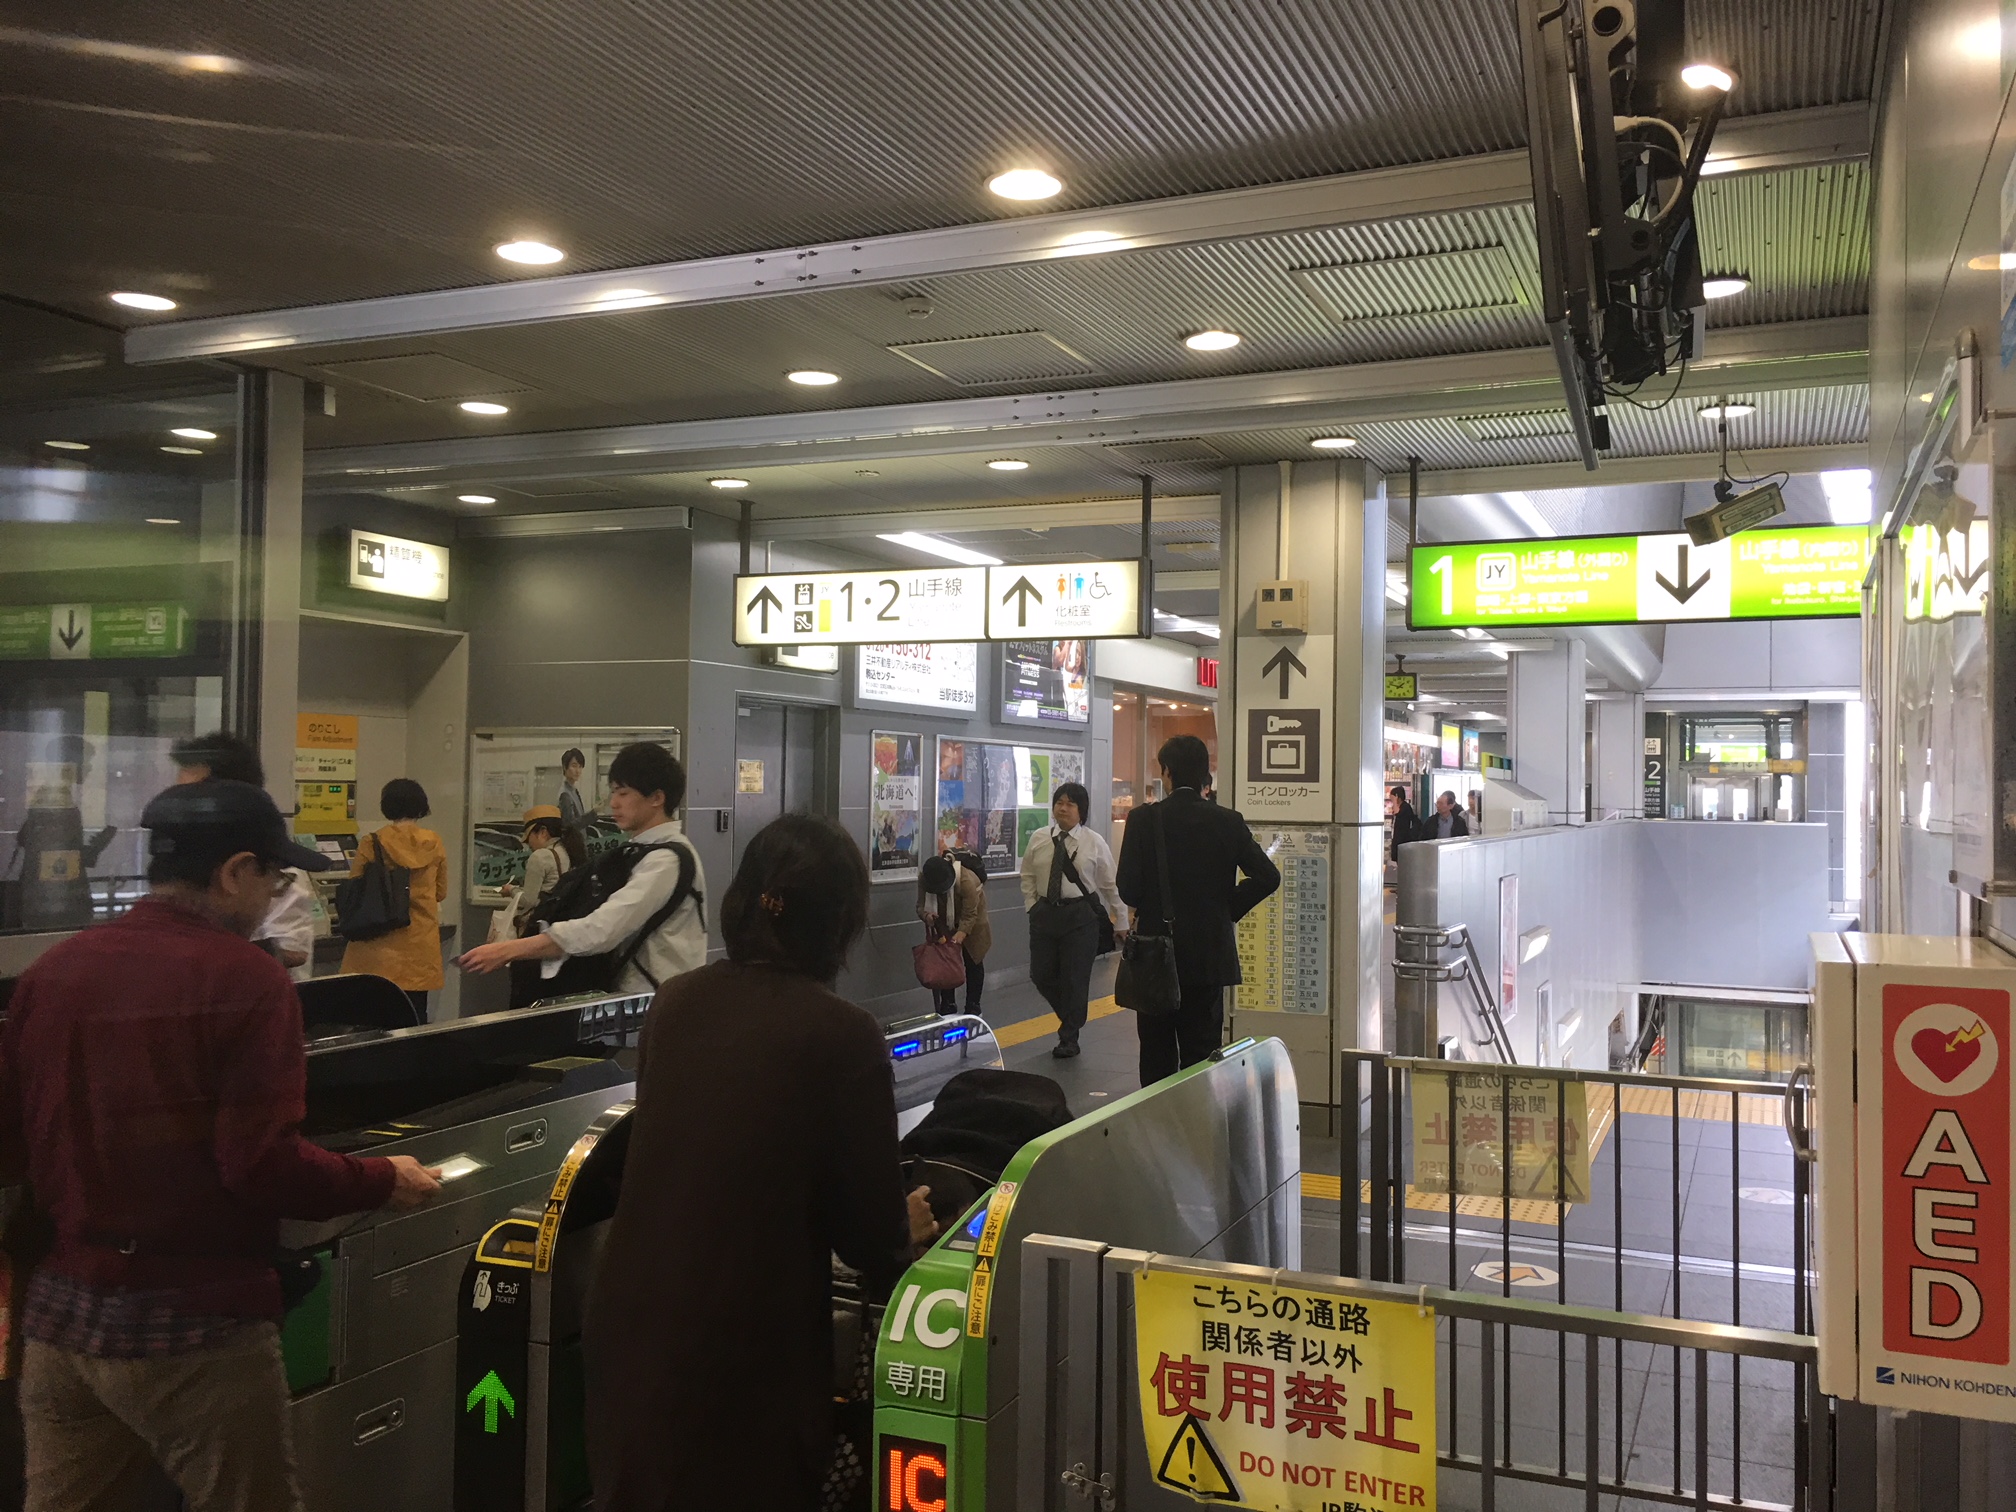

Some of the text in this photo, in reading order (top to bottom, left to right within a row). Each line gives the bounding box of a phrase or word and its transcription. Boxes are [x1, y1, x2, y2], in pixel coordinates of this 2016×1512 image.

[1486, 565, 1506, 579] JY
[1583, 571, 1609, 581] Line
[1830, 560, 1858, 571] Line
[908, 577, 963, 597] 山手線
[1429, 555, 1453, 616] 1
[1056, 604, 1091, 617] 化粧室
[866, 668, 896, 680] 駒込センター
[939, 688, 974, 704] 当駅徒歩3分
[308, 723, 341, 734] のりこし
[1648, 761, 1661, 779] 2
[1247, 786, 1320, 797] コインロッカー
[980, 1195, 1008, 1254] かけこみ禁止
[1901, 1108, 1991, 1342] AED
[496, 1280, 520, 1294] きっぷ
[494, 1295, 516, 1304] TICKET
[969, 1274, 988, 1335] 扉にご注意
[1193, 1284, 1371, 1336] こちらの通路
[889, 1284, 966, 1349] IC
[1201, 1320, 1363, 1373] 関係者以外
[886, 1360, 946, 1402] 専用
[1900, 1372, 2016, 1398] NIHON KOHDEN
[1150, 1351, 1420, 1454] 使用禁止
[890, 1450, 946, 1512] IC
[1240, 1451, 1426, 1507] DO NOT ENTER
